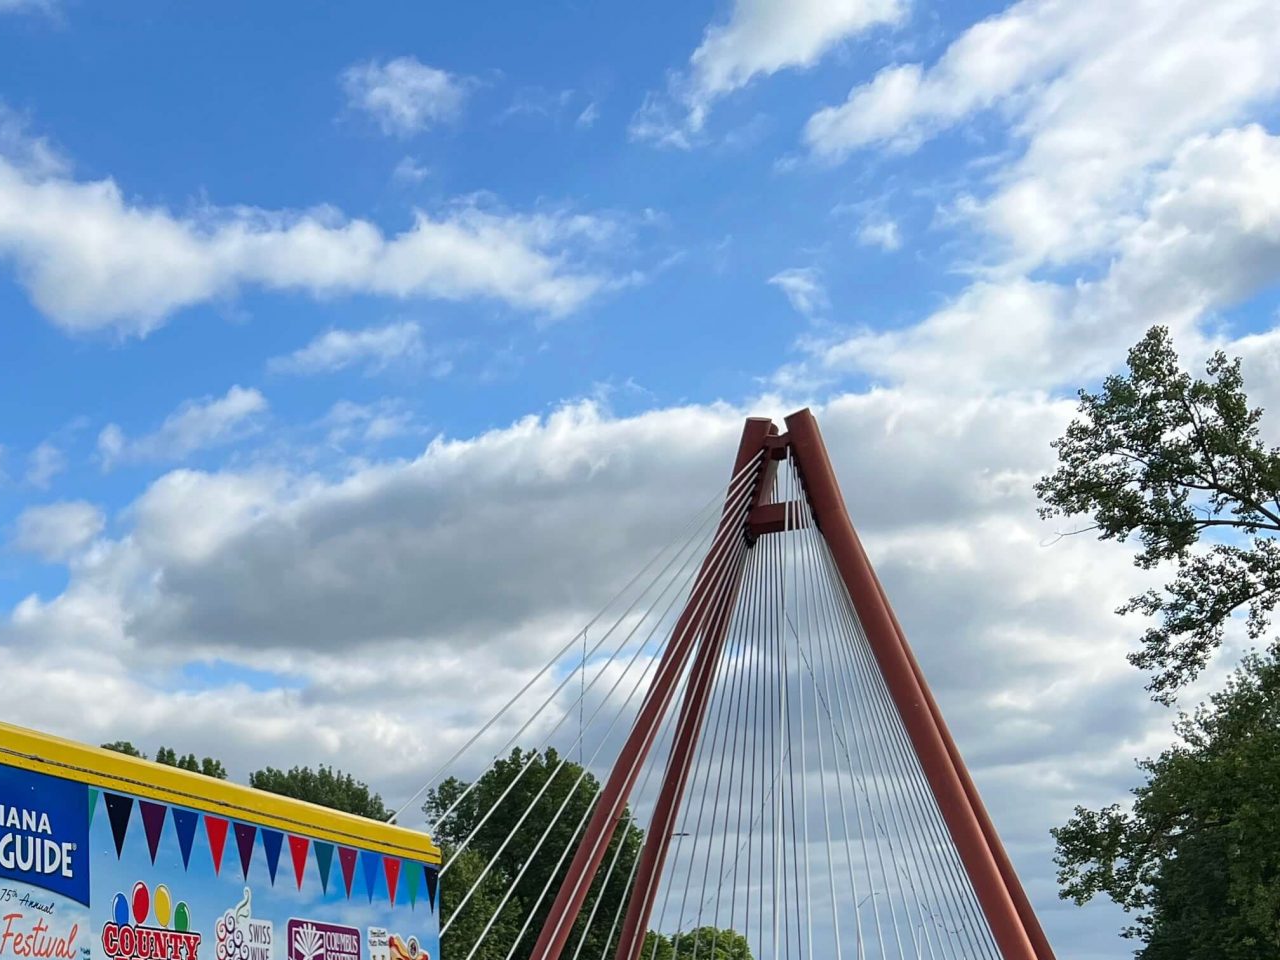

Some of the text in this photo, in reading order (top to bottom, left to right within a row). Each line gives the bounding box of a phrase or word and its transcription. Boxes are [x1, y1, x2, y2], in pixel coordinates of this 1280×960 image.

[0, 888, 18, 902] 75th
[19, 892, 54, 915] Annual
[0, 913, 79, 960] Festival
[249, 924, 271, 945] SWISS
[326, 932, 359, 953] COLUMBUS
